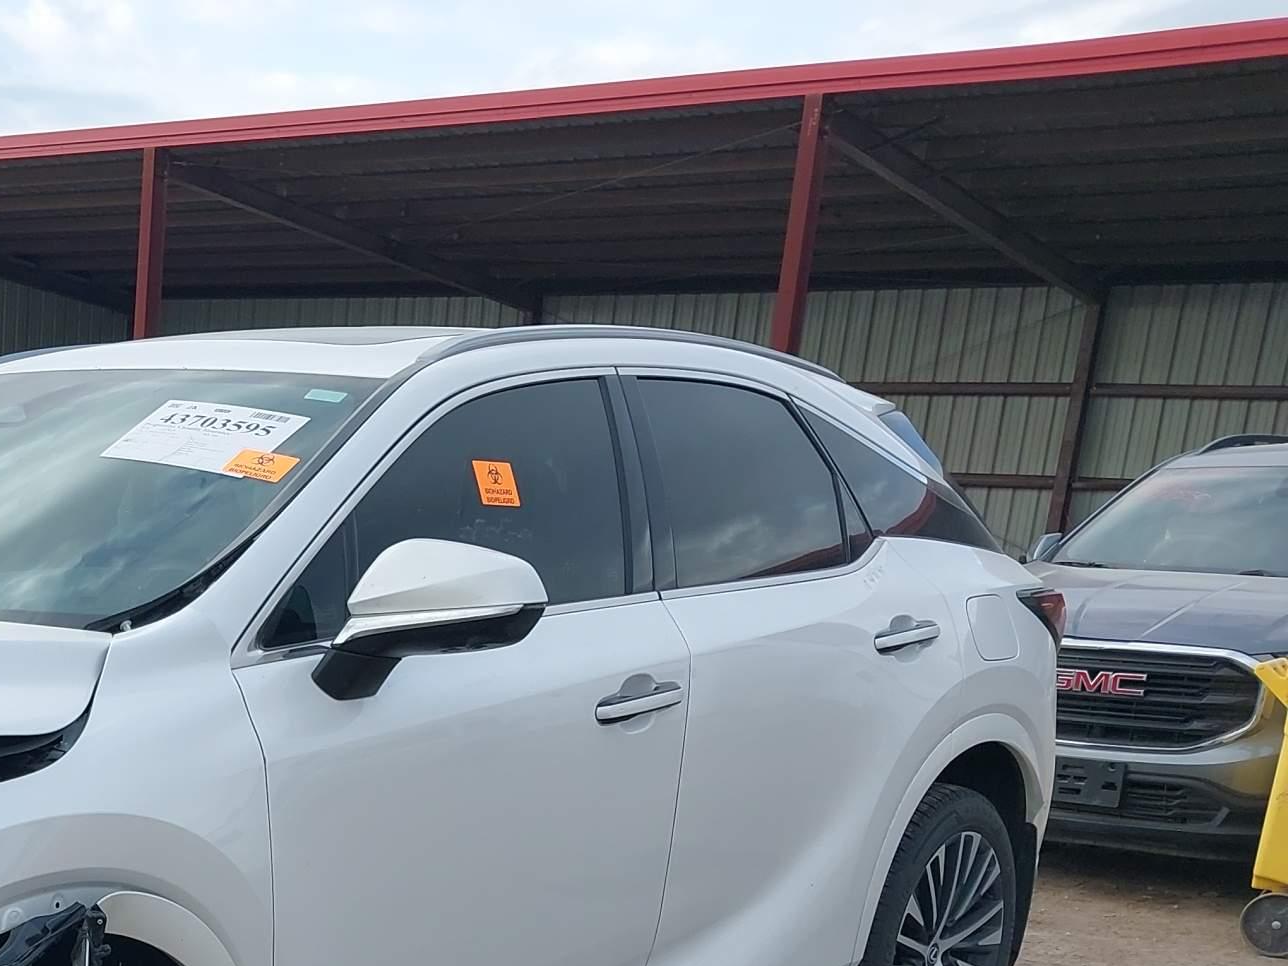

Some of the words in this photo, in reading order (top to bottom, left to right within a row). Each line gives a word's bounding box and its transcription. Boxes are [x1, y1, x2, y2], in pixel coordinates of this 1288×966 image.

[158, 412, 277, 437] 43703595
[233, 463, 277, 475] BIOHAZARD
[484, 488, 513, 496] BIOHAZARD
